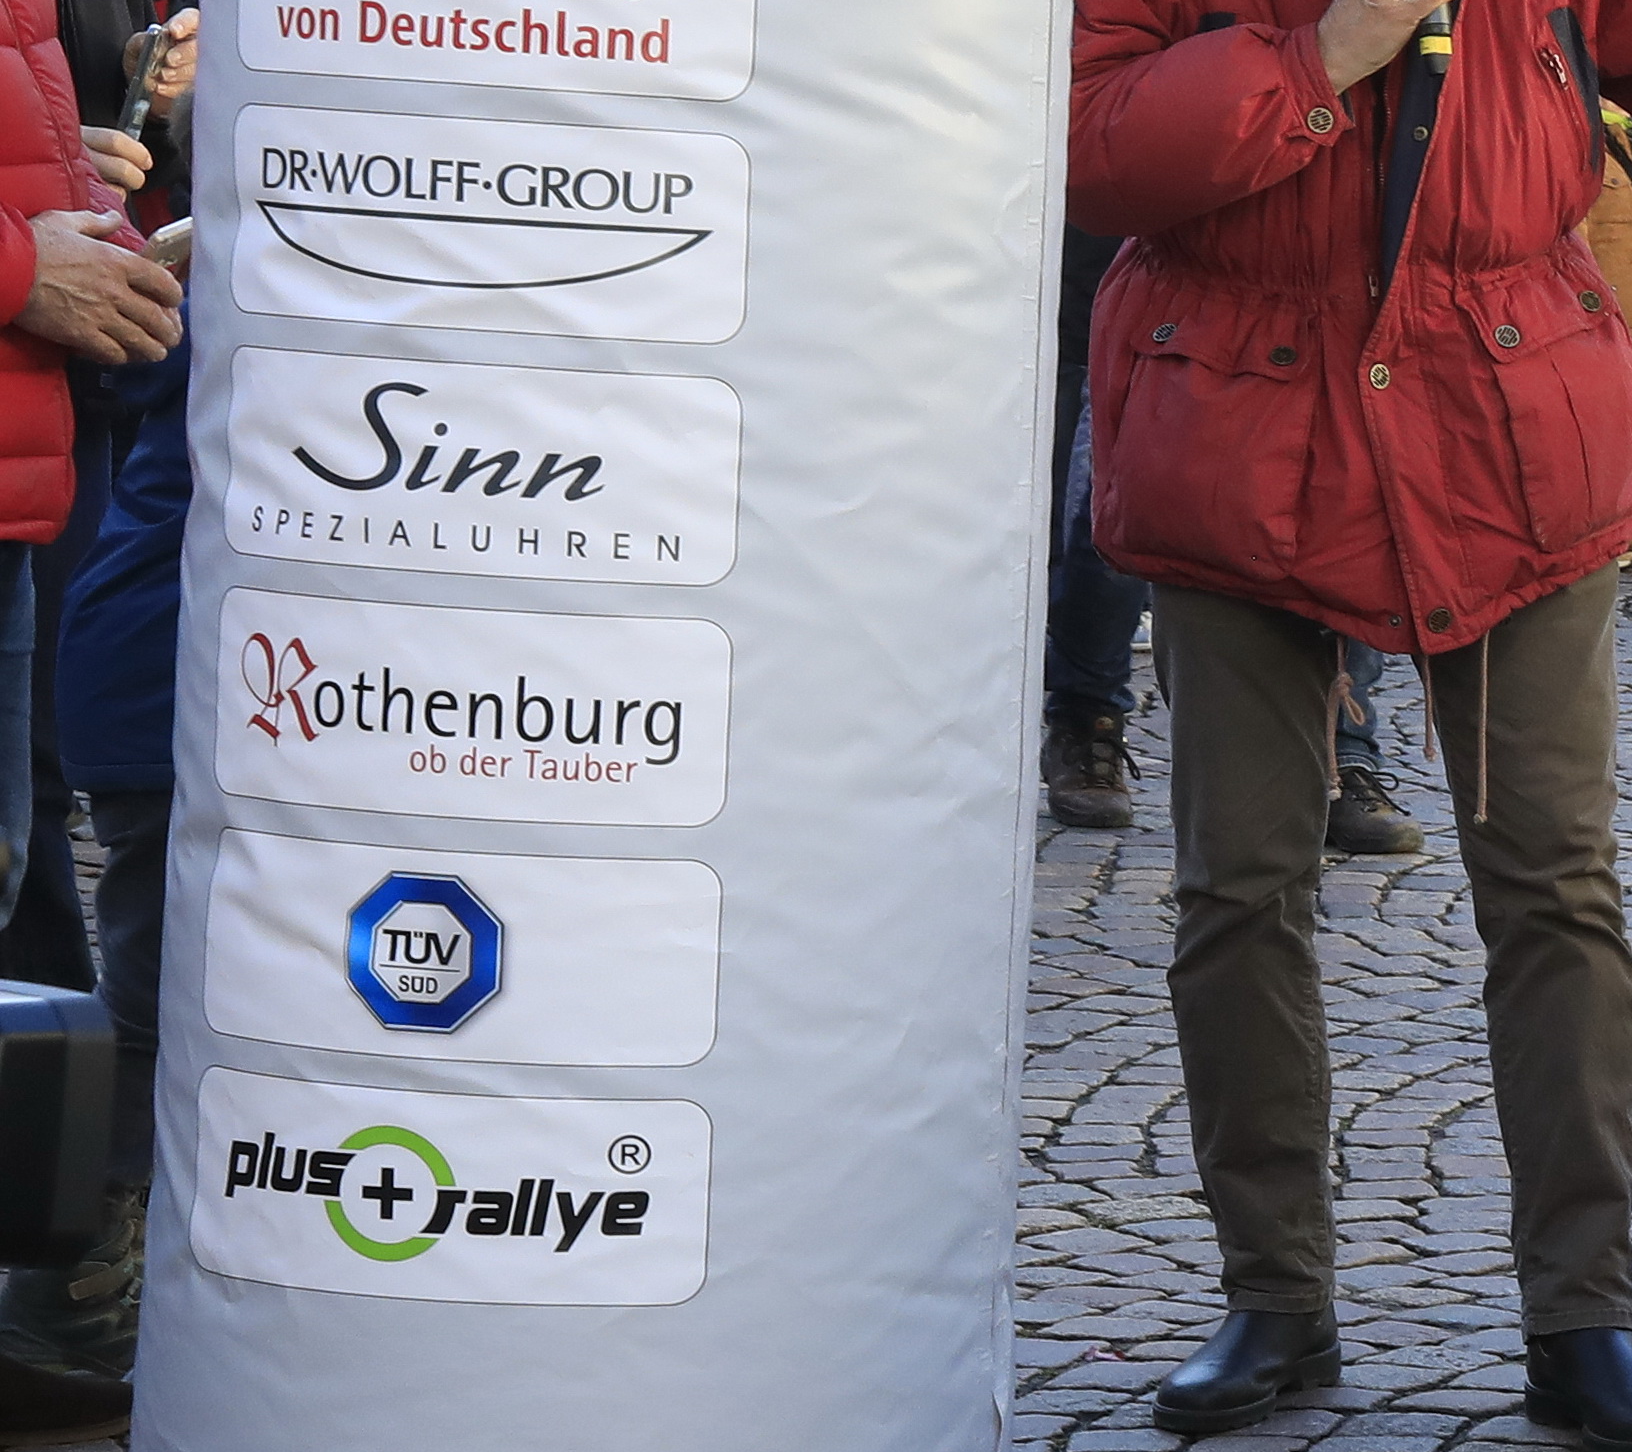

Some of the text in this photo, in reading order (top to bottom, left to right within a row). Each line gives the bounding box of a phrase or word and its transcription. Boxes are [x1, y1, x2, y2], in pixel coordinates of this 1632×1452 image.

[276, 0, 671, 65] von Deutschland
[291, 381, 606, 503] Sinn
[251, 506, 683, 563] SPEZIALUHREN
[241, 632, 683, 766] Rothenburg
[408, 744, 638, 785] ob der Tauber
[382, 928, 462, 967] TÜV
[397, 974, 439, 996] SÜD
[224, 1131, 358, 1198] plus
[420, 1178, 651, 1253] rallye
